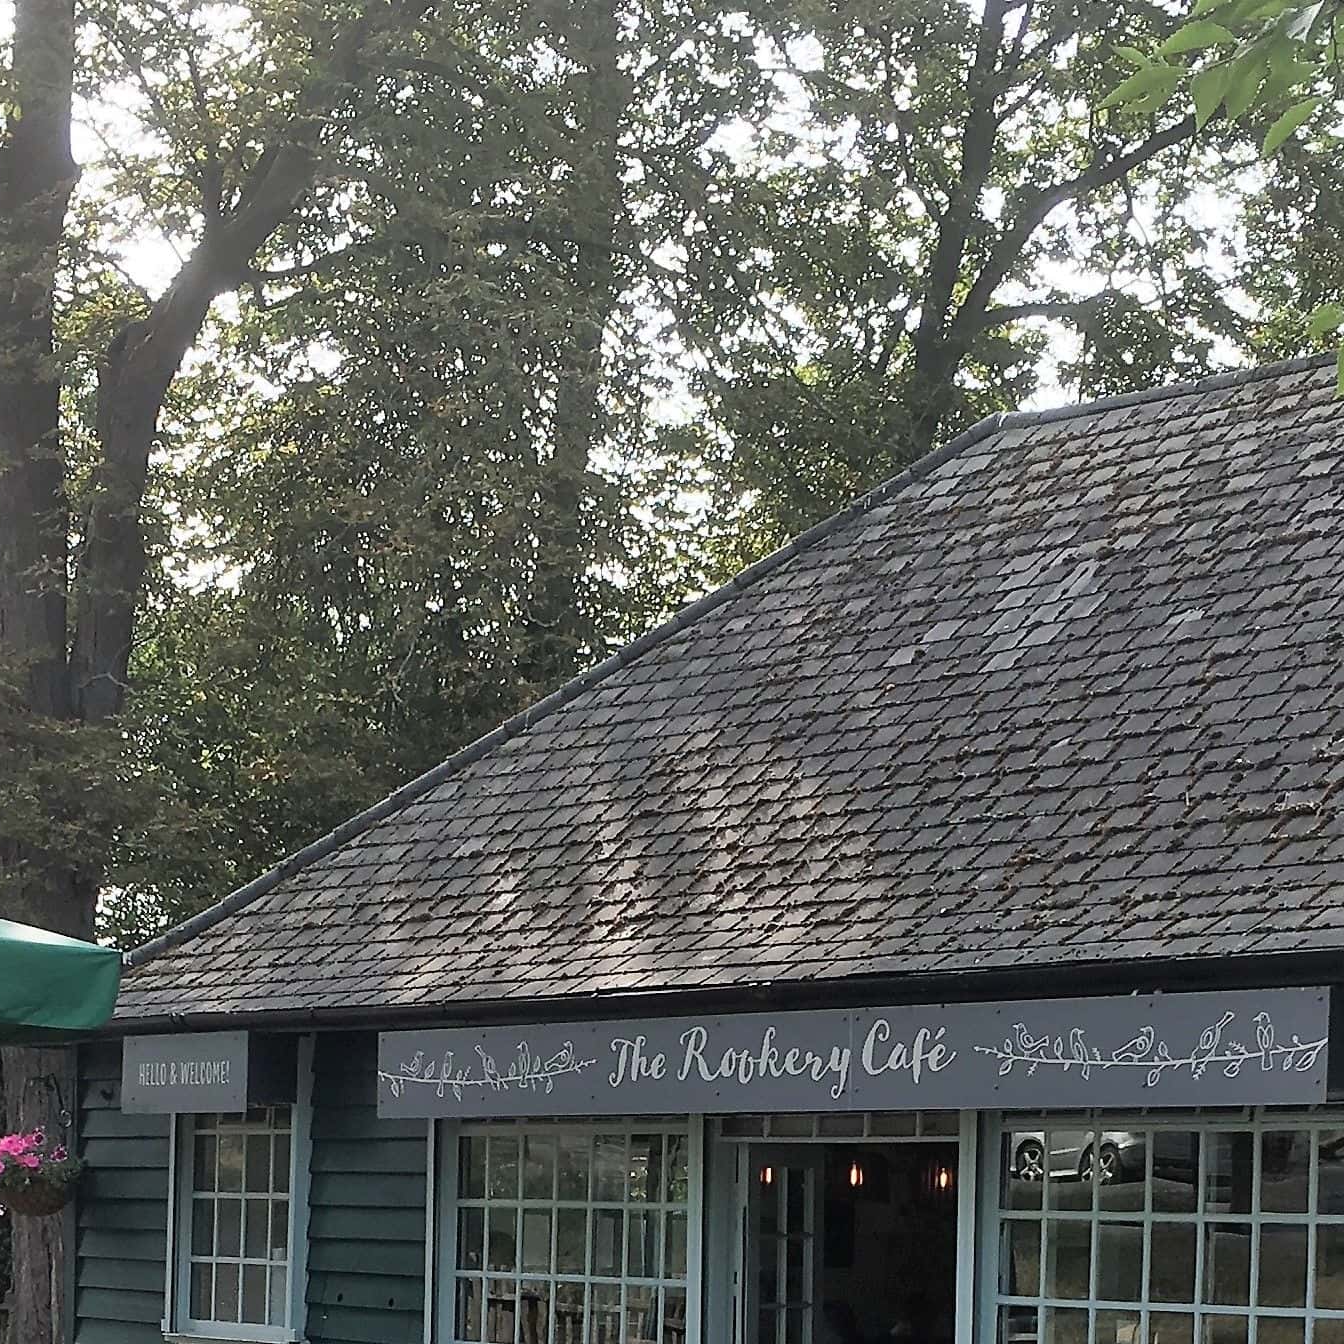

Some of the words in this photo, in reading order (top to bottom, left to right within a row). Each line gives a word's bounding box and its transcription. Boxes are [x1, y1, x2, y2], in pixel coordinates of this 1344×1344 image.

[138, 1063, 167, 1086] HELLO
[170, 1062, 178, 1085] &
[180, 1061, 230, 1085] WELCOME!
[609, 1035, 667, 1087] The
[677, 1026, 851, 1099] Rookery
[862, 1019, 957, 1083] Café
